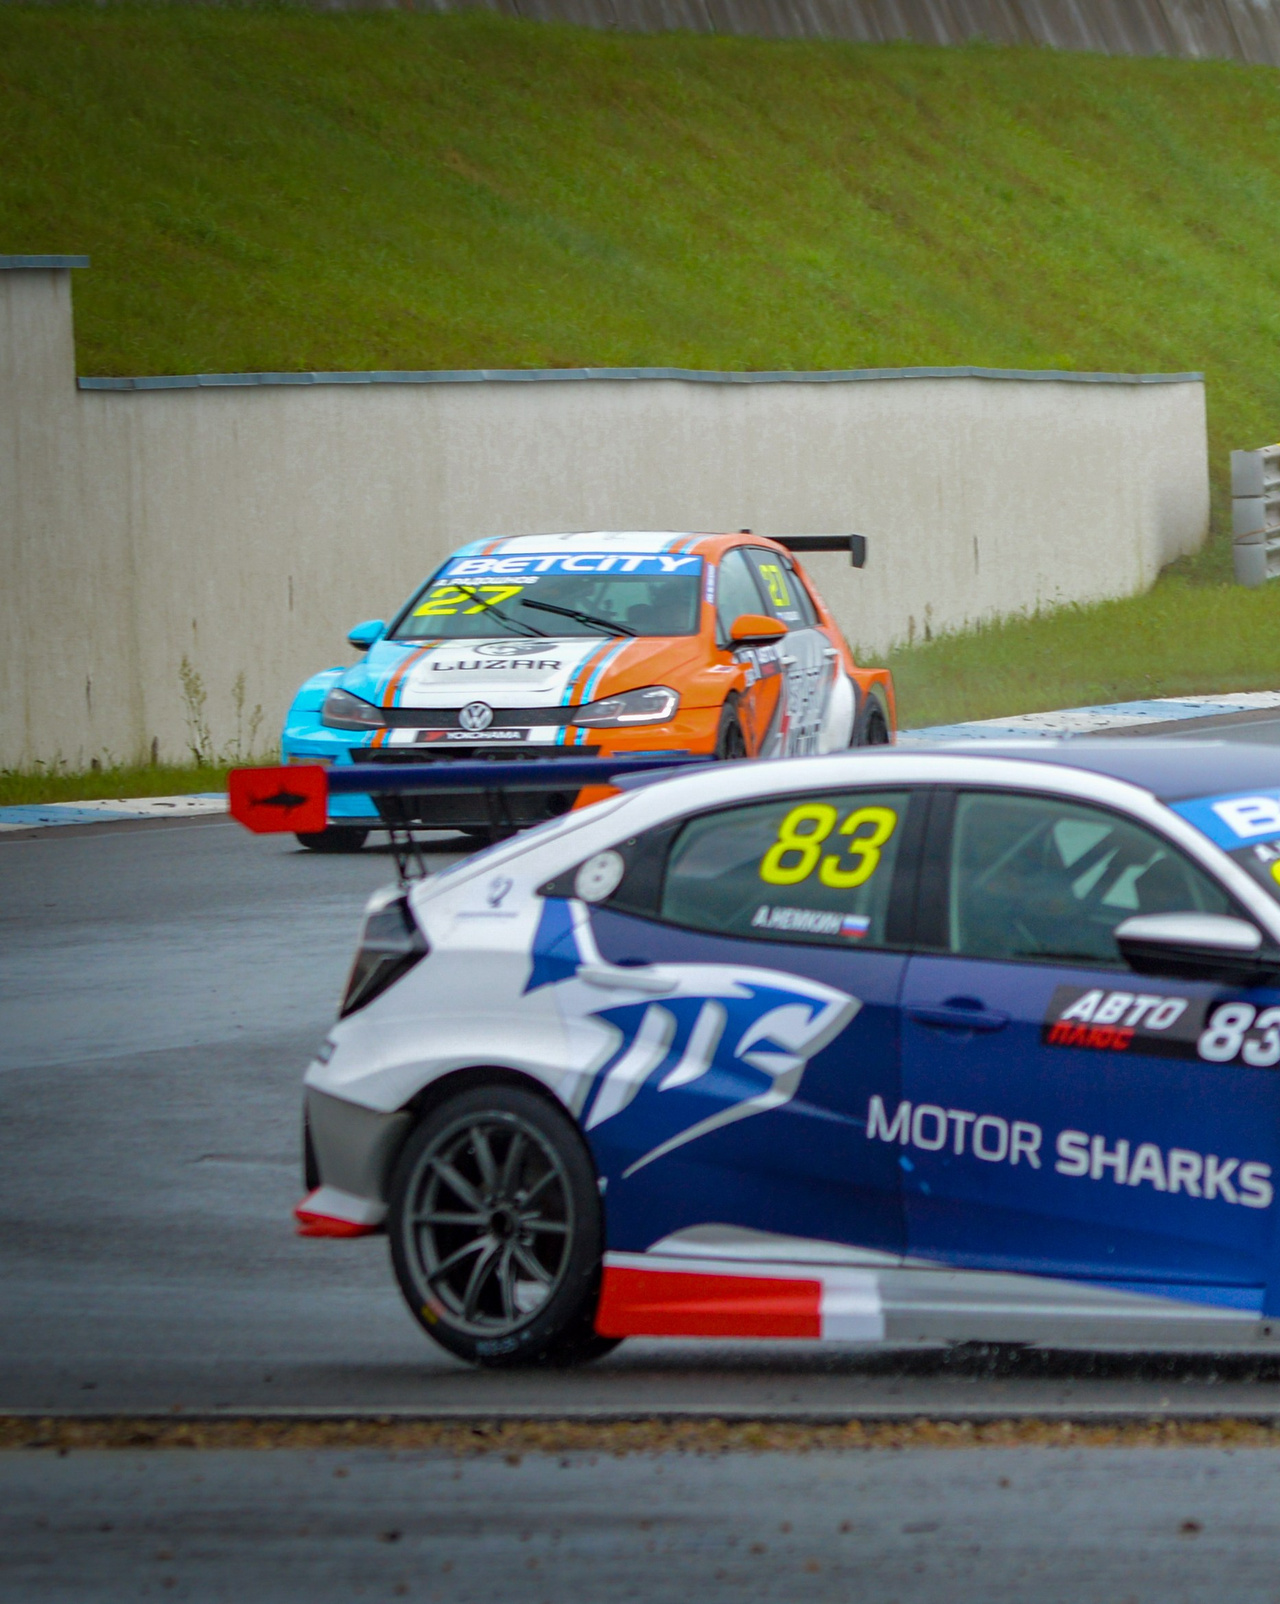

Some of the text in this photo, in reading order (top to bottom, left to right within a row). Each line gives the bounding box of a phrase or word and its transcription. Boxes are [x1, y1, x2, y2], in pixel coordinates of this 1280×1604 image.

[447, 555, 699, 576] BETCITY
[412, 585, 524, 617] 27
[432, 659, 561, 672] LUZAR
[445, 730, 521, 740] YOKOHAMA
[759, 803, 898, 888] 83
[867, 1095, 1274, 1209] MOTOR SHARKS
